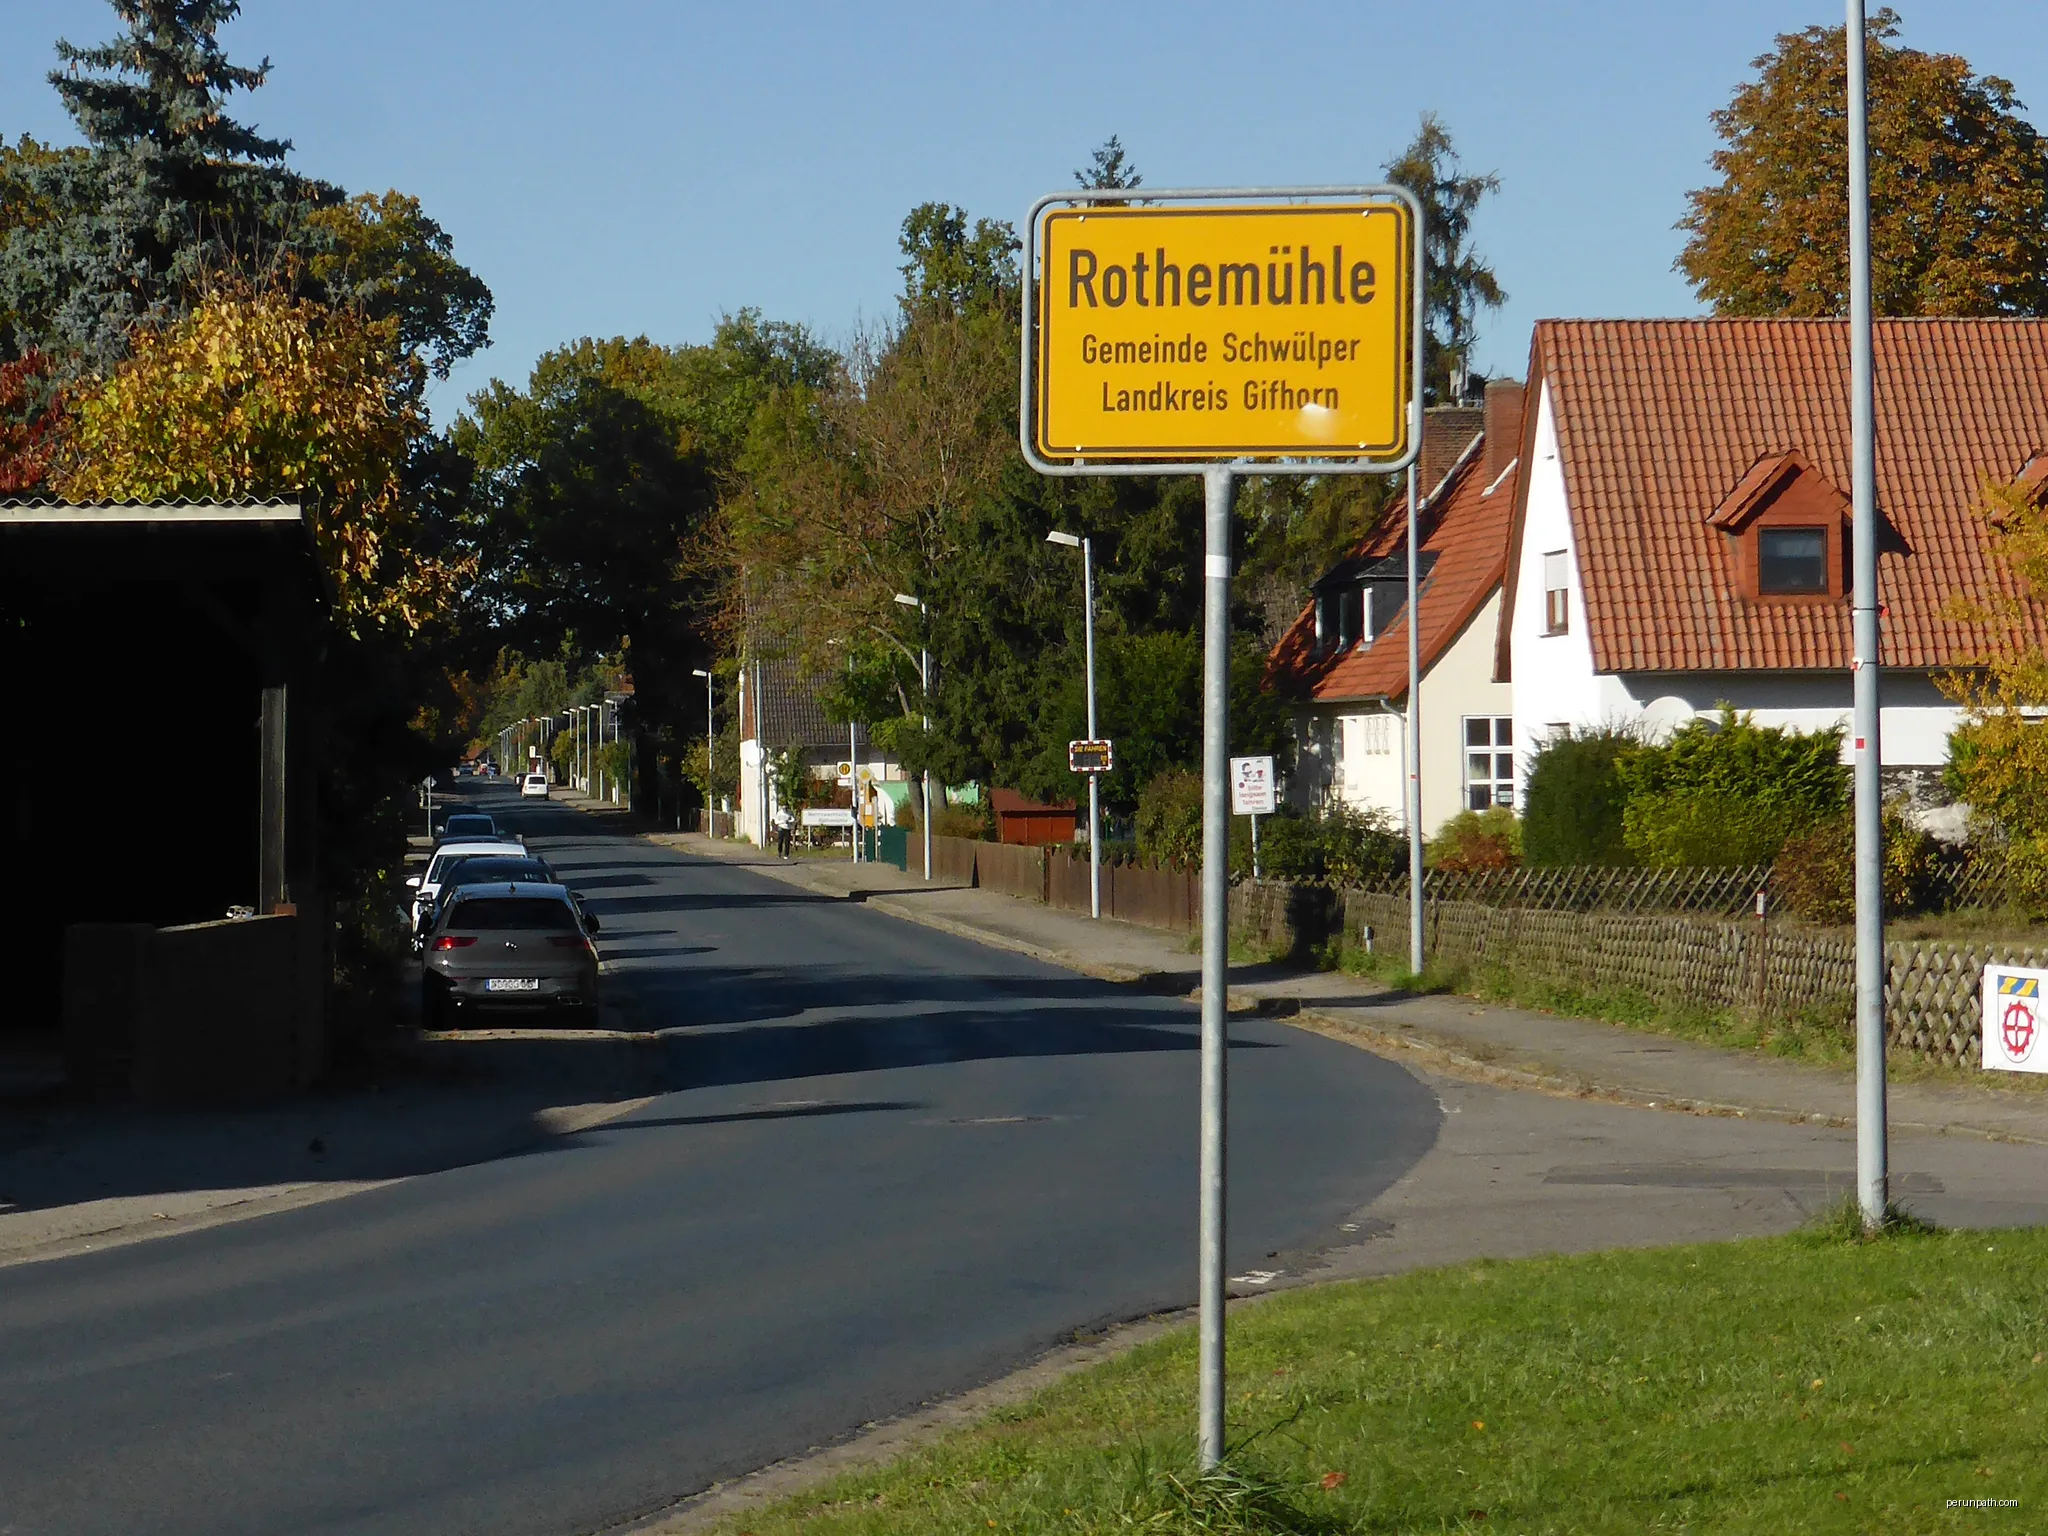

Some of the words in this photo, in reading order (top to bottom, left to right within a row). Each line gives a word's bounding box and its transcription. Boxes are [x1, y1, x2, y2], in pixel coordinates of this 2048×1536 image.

[1069, 245, 1376, 308] Rothemühle
[1082, 333, 1207, 364] Gemeinde
[1222, 331, 1360, 370] Schwülper
[1102, 381, 1228, 412] Landkreis
[1243, 380, 1339, 411] Gifhorn
